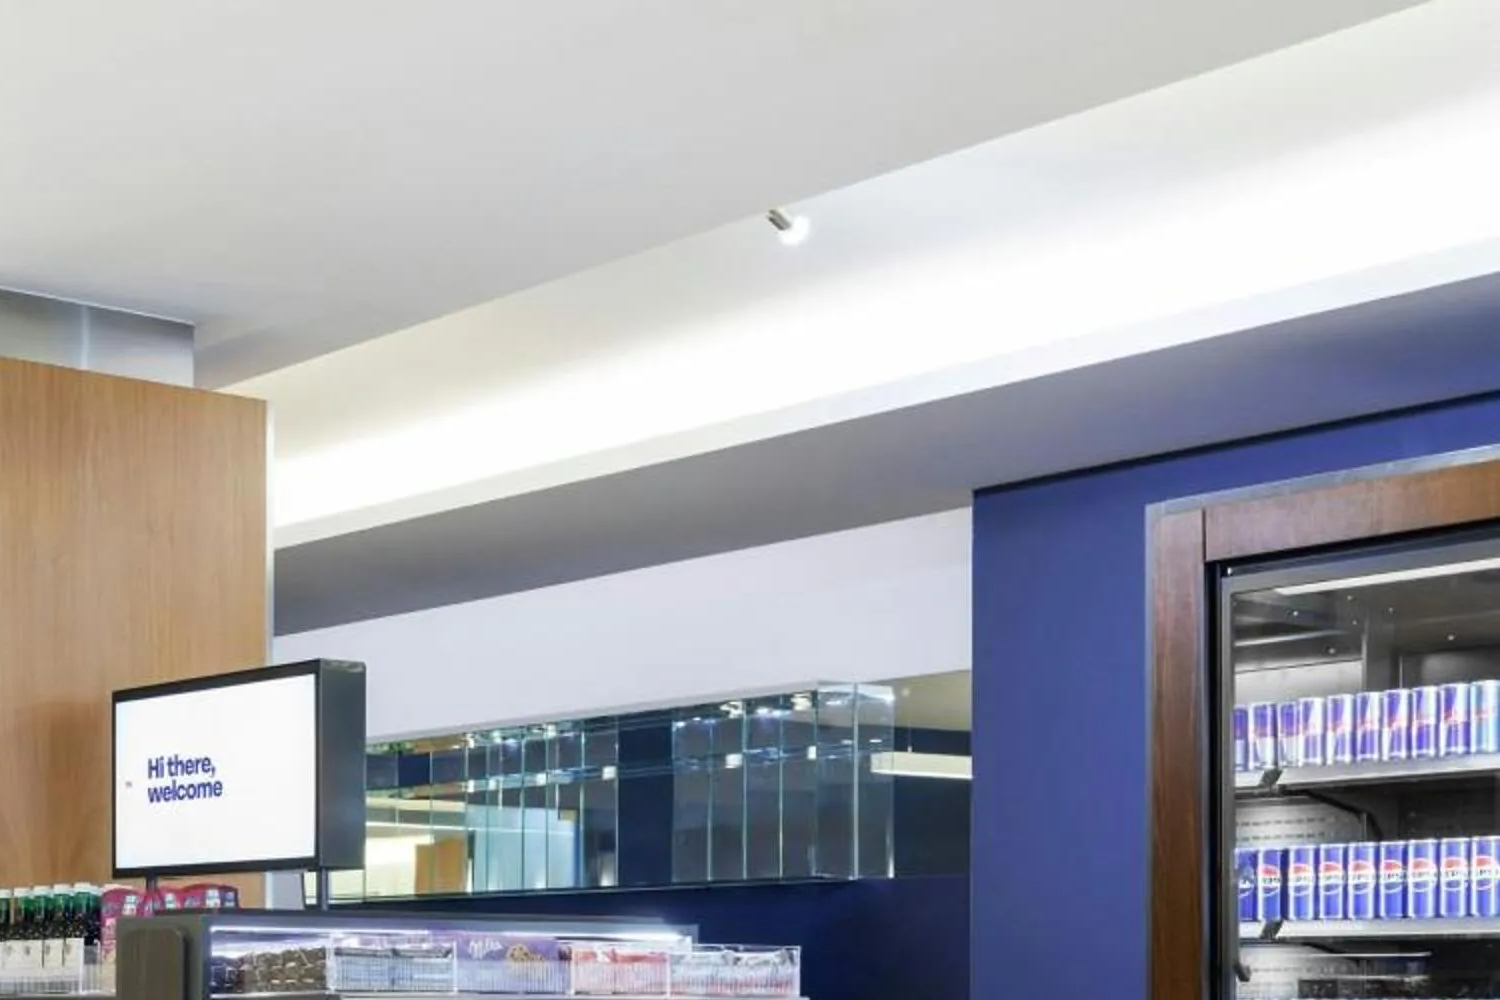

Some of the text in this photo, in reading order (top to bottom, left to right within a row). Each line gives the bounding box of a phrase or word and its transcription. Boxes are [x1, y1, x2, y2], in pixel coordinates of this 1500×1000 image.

[148, 754, 216, 778] Hi there,
[148, 779, 223, 802] welcome
